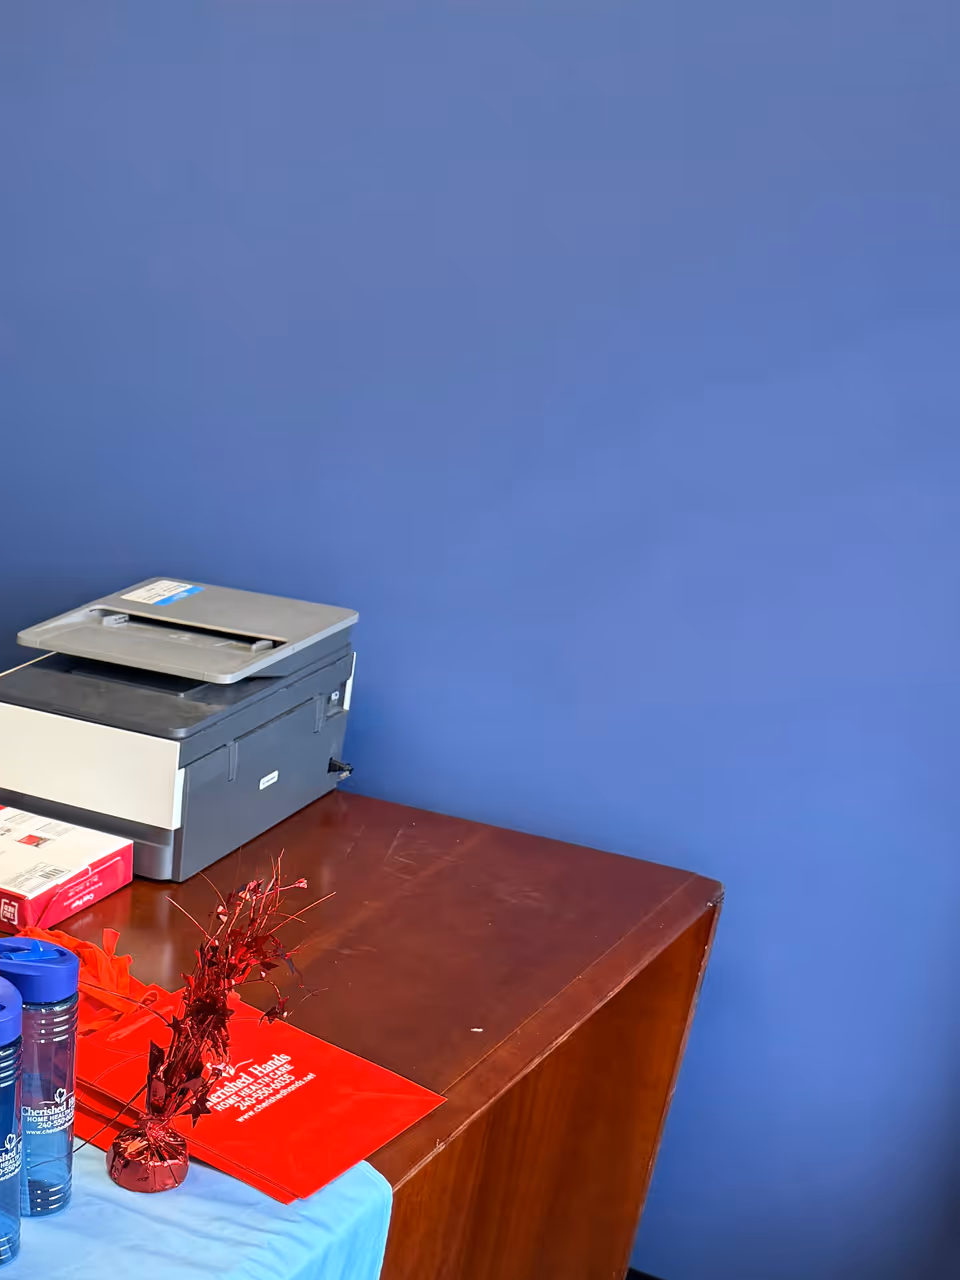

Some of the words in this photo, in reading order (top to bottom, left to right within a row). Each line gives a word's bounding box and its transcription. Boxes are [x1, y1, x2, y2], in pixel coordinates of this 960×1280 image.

[205, 1072, 254, 1108] erished
[248, 1053, 292, 1077] Hands
[214, 1093, 239, 1112] HOME
[238, 1077, 270, 1099] HEALTH
[269, 1063, 294, 1081] CARE
[235, 1073, 295, 1111] 240-550-6035
[21, 1101, 67, 1116] Cherished
